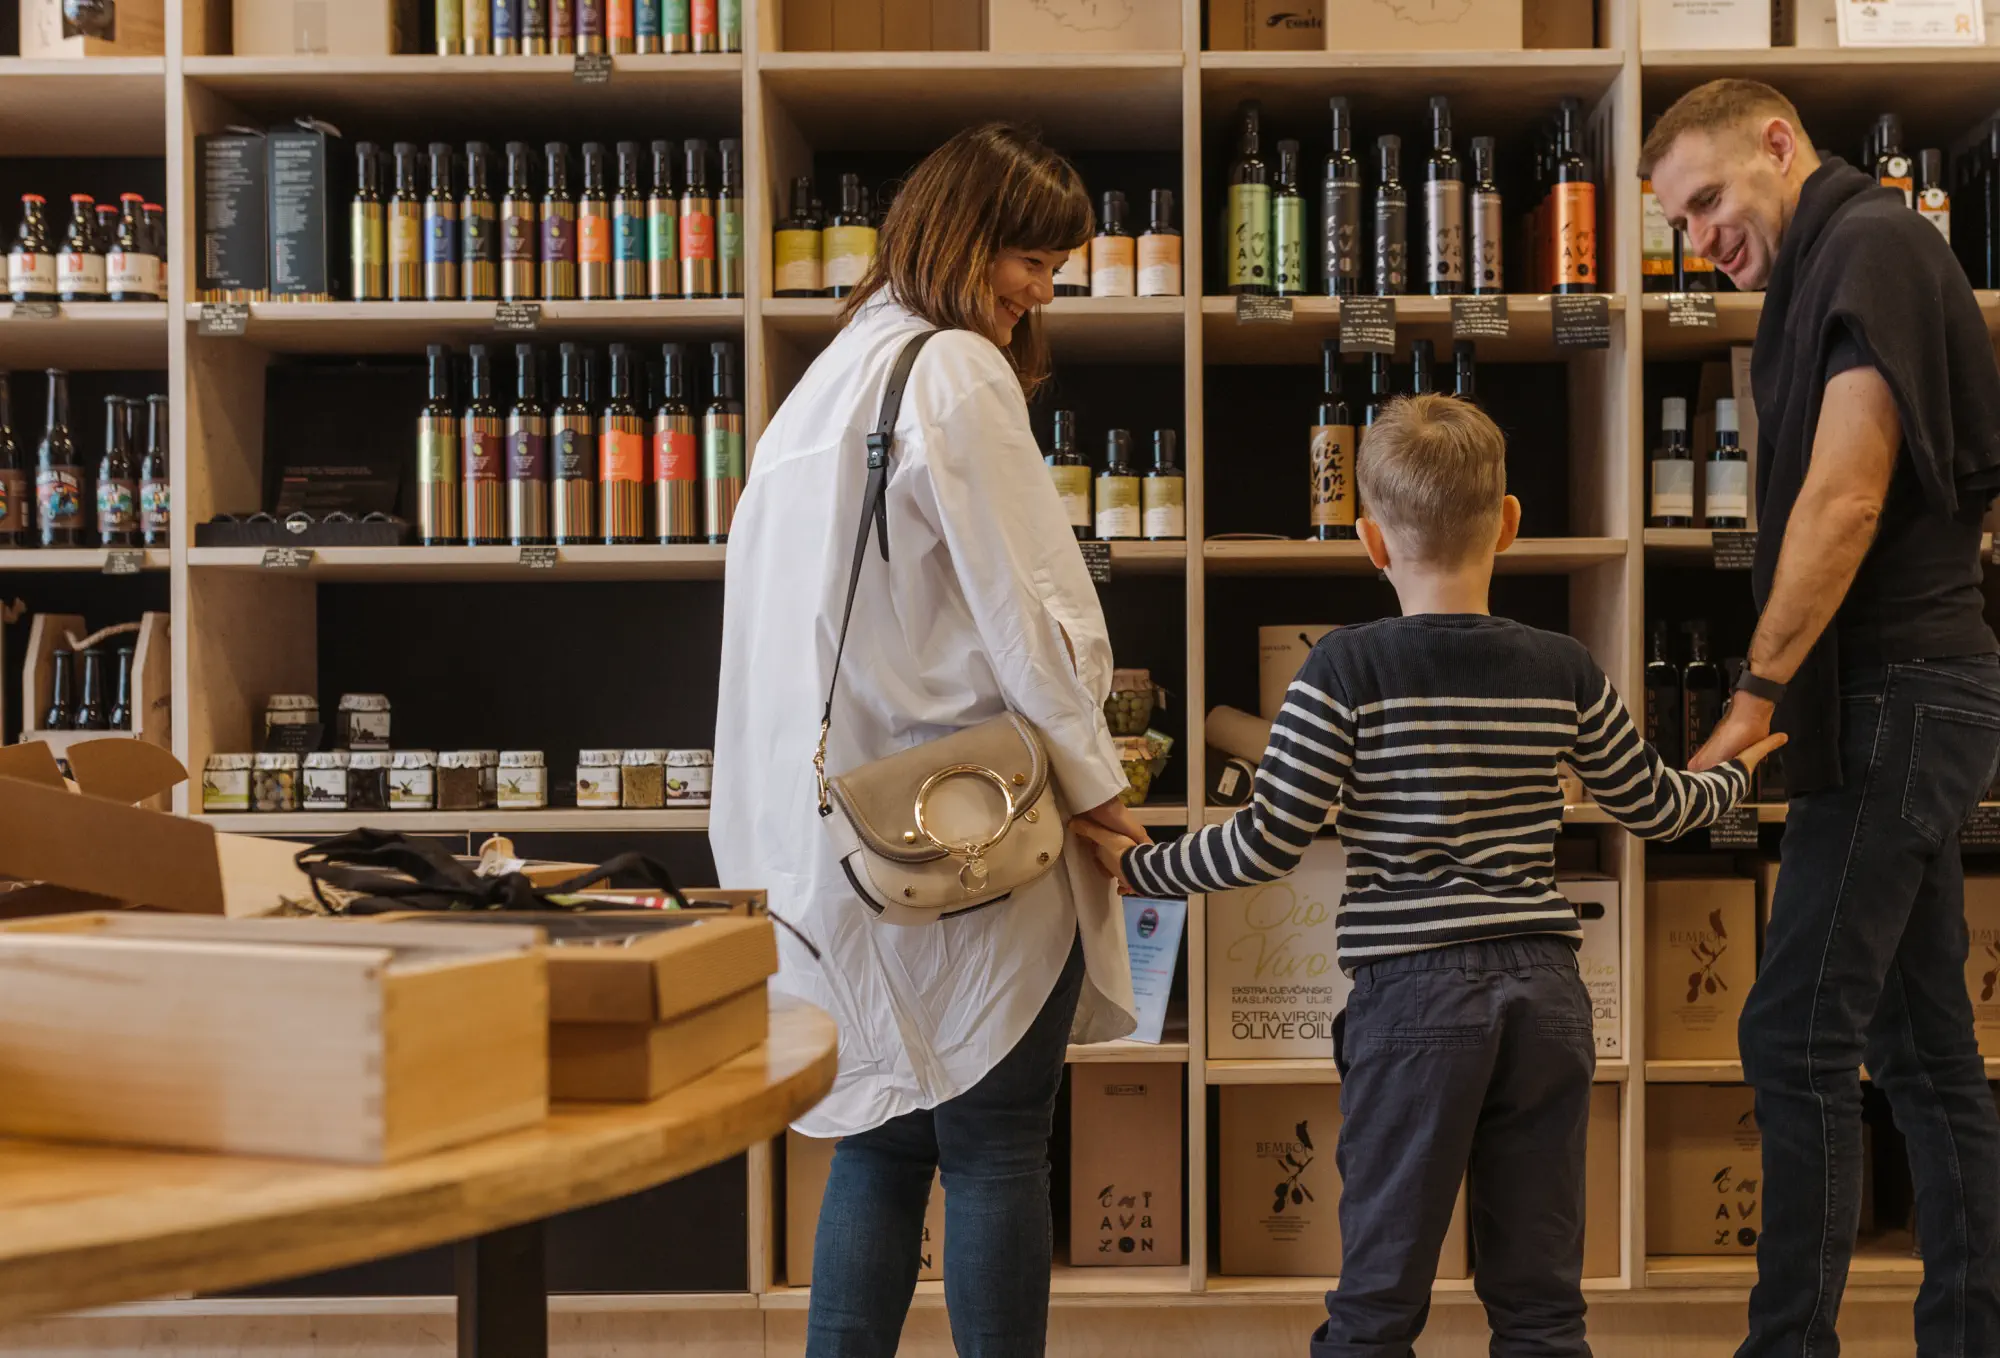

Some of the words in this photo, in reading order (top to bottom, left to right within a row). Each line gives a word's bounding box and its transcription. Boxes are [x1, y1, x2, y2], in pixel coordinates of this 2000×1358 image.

[1669, 930, 1717, 943] BEMBO
[1227, 932, 1332, 981] Vivo
[1232, 986, 1267, 995] EKSTRA
[1269, 984, 1332, 995] DJEVIČANSKO
[1232, 995, 1297, 1004] MASLINOVO
[1306, 995, 1332, 1004] ULJE
[1232, 1011, 1279, 1023] EXTRA
[1282, 1011, 1332, 1023] VIRGIN
[1593, 1007, 1617, 1020] OIL
[1232, 1023, 1295, 1040] OLIVE
[1299, 1023, 1333, 1040] OIL
[1256, 1142, 1304, 1154] BEMBO
